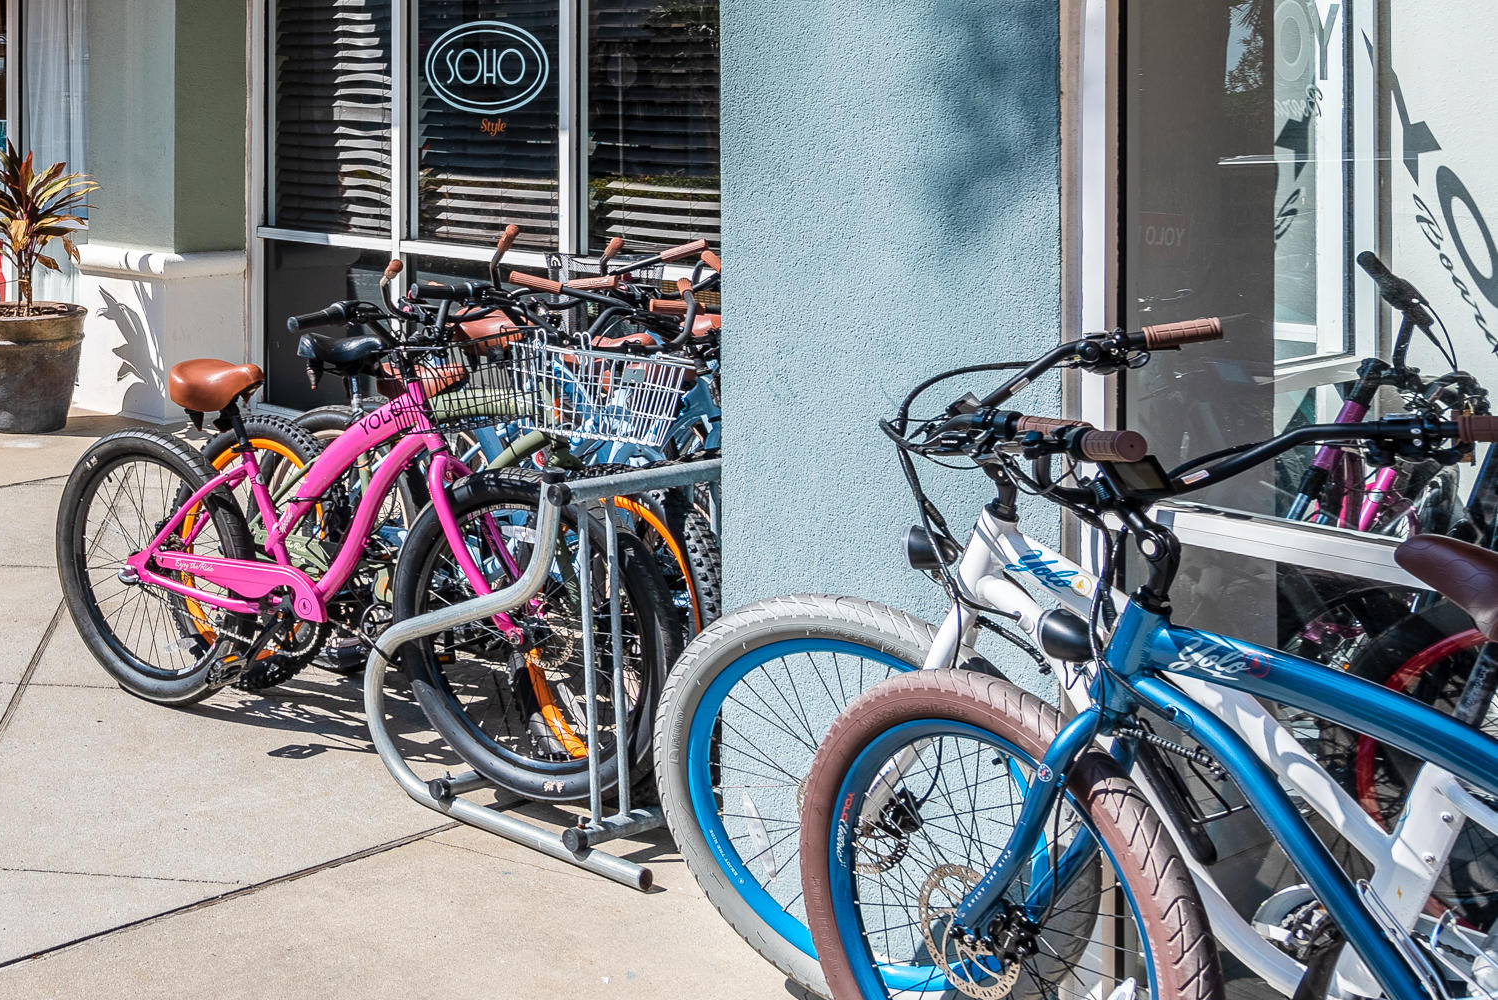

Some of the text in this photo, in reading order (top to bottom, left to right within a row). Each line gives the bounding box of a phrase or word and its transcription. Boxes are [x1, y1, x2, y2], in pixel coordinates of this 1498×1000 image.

[445, 47, 526, 85] SOHO
[480, 118, 507, 136] Style
[359, 400, 403, 436] YOLO
[1005, 549, 1079, 593] Yolo
[1168, 636, 1252, 681] Yolo
[840, 792, 855, 822] YOLO
